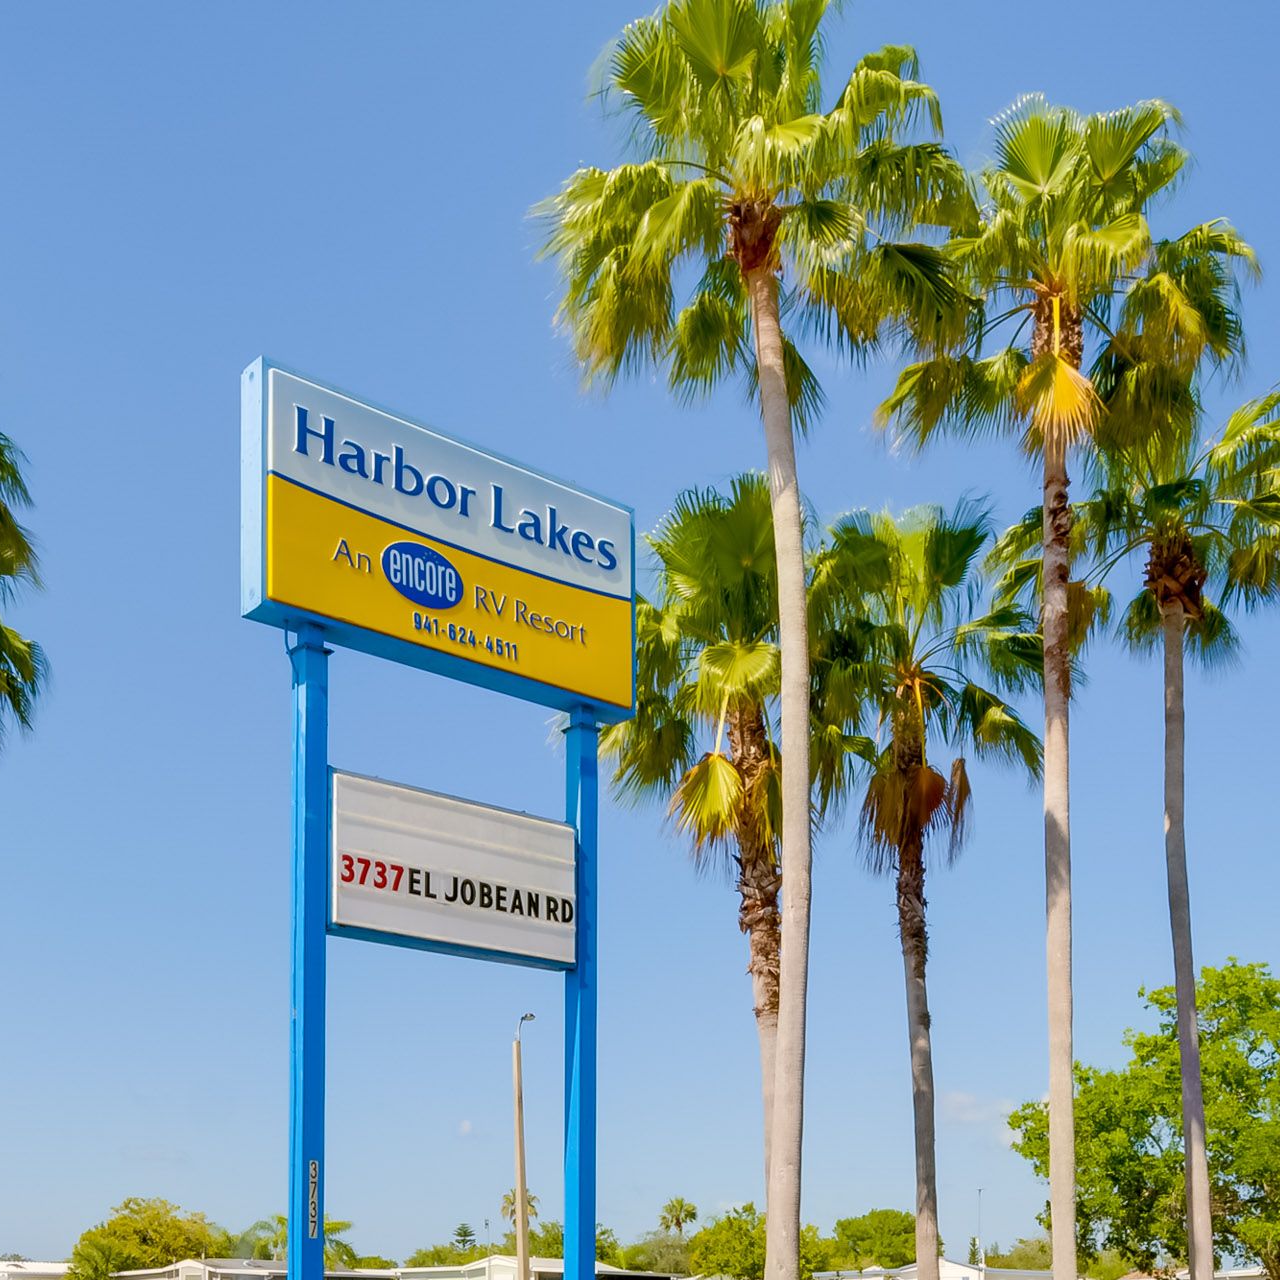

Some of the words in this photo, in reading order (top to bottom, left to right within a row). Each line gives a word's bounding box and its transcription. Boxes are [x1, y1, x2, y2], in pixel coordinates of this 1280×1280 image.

[293, 404, 476, 518] Harbor
[490, 482, 617, 571] Lakes
[332, 538, 371, 574] An
[389, 549, 457, 602] encore
[473, 585, 507, 616] RV
[515, 600, 588, 645] Resort
[412, 612, 519, 661] 941-624-4511
[340, 854, 404, 892] 3737
[408, 868, 437, 899] EL
[444, 877, 540, 918] JOBEAN
[546, 896, 574, 923] RD
[310, 1161, 318, 1237] 3737
